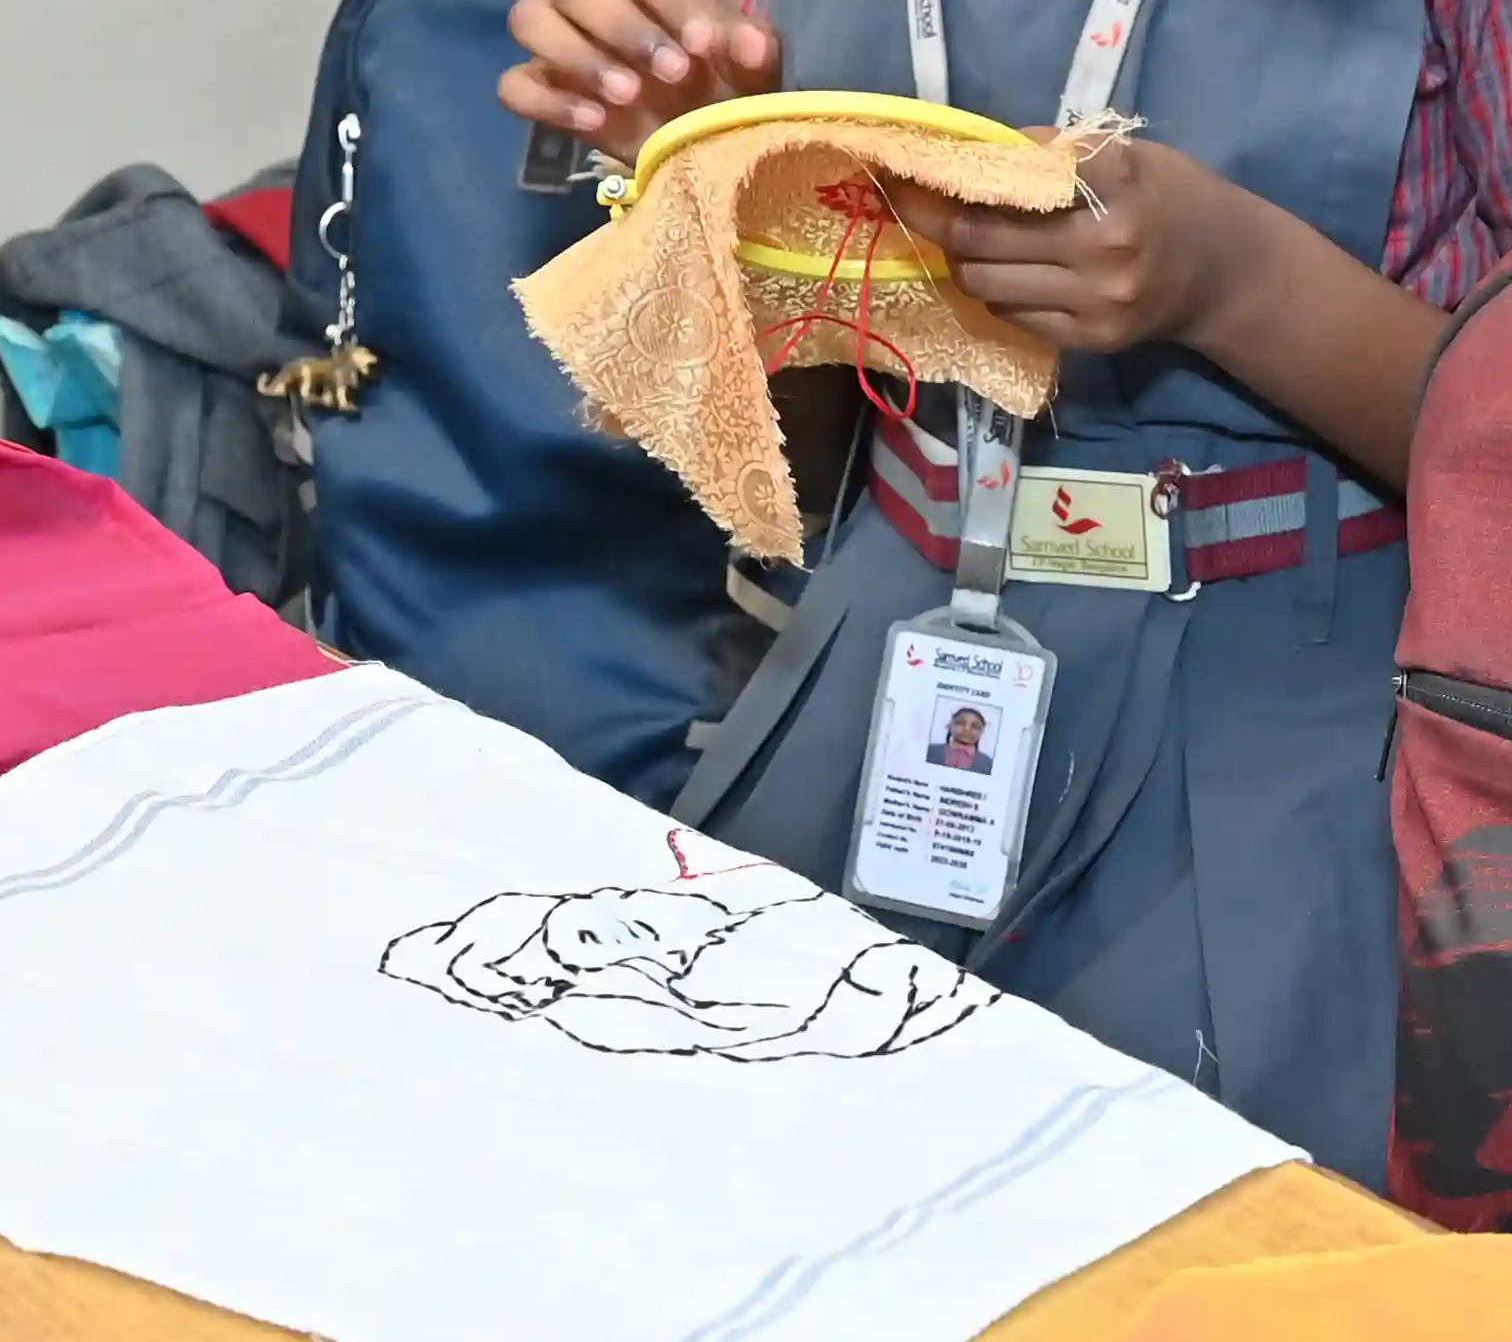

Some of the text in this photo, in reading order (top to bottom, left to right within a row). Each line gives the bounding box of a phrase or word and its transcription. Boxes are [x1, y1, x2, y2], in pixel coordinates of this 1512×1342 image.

[1020, 535, 1136, 560] Samved School
[972, 655, 1003, 674] School
